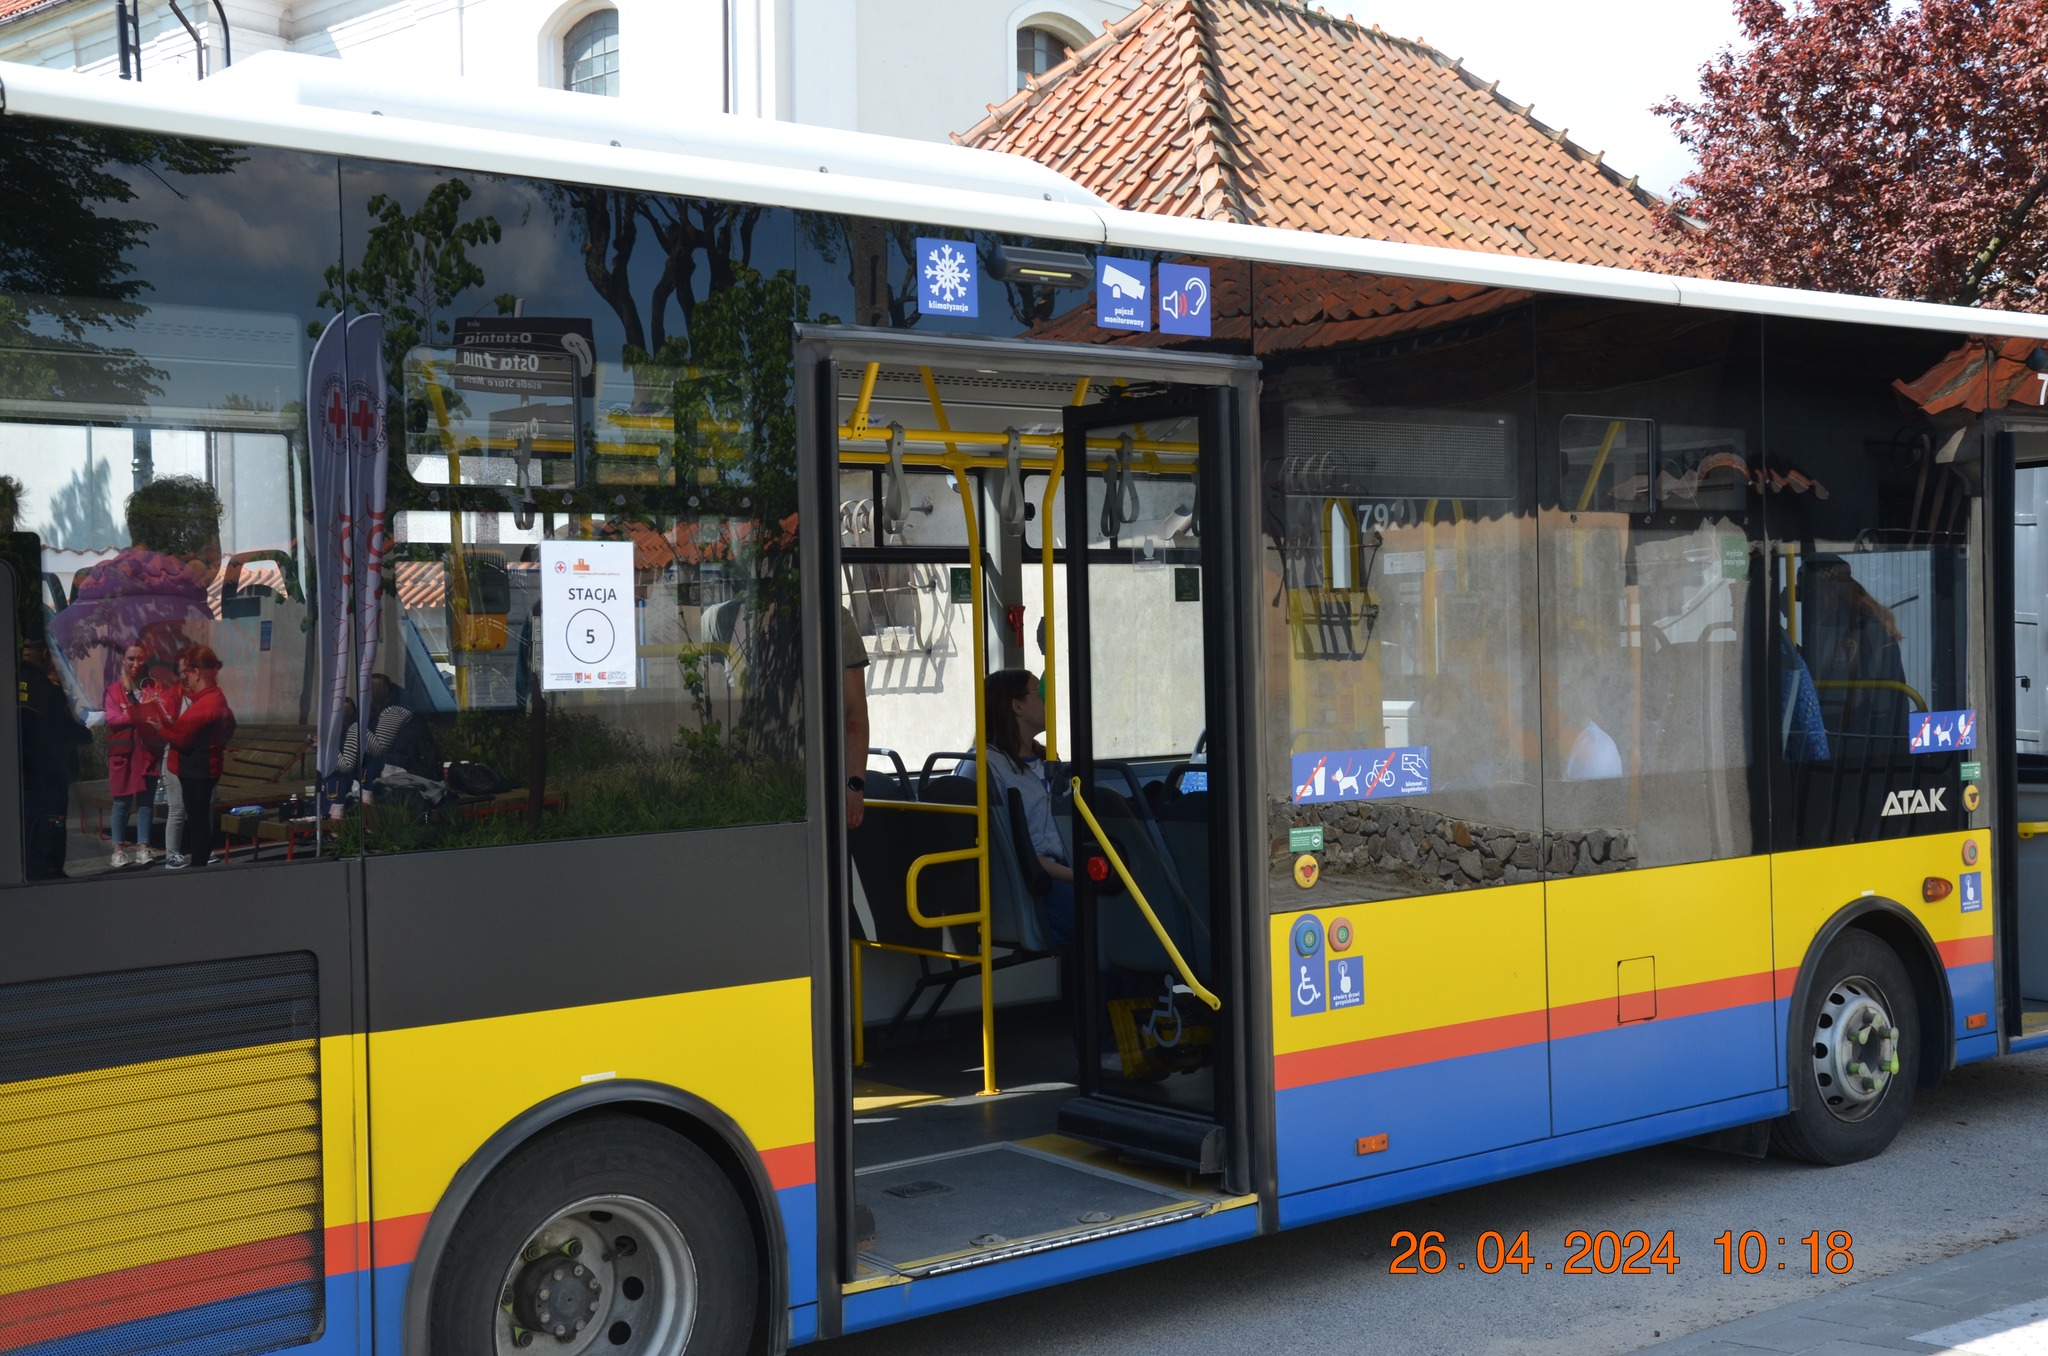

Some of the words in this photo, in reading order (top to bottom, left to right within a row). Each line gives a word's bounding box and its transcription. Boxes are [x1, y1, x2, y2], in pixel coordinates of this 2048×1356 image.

[928, 300, 968, 312] klimatyzacja
[1114, 307, 1134, 316] pojazd
[1104, 315, 1144, 328] monitorowany
[568, 588, 617, 603] STACJA
[586, 629, 595, 644] 5
[1881, 787, 1947, 816] ATAK
